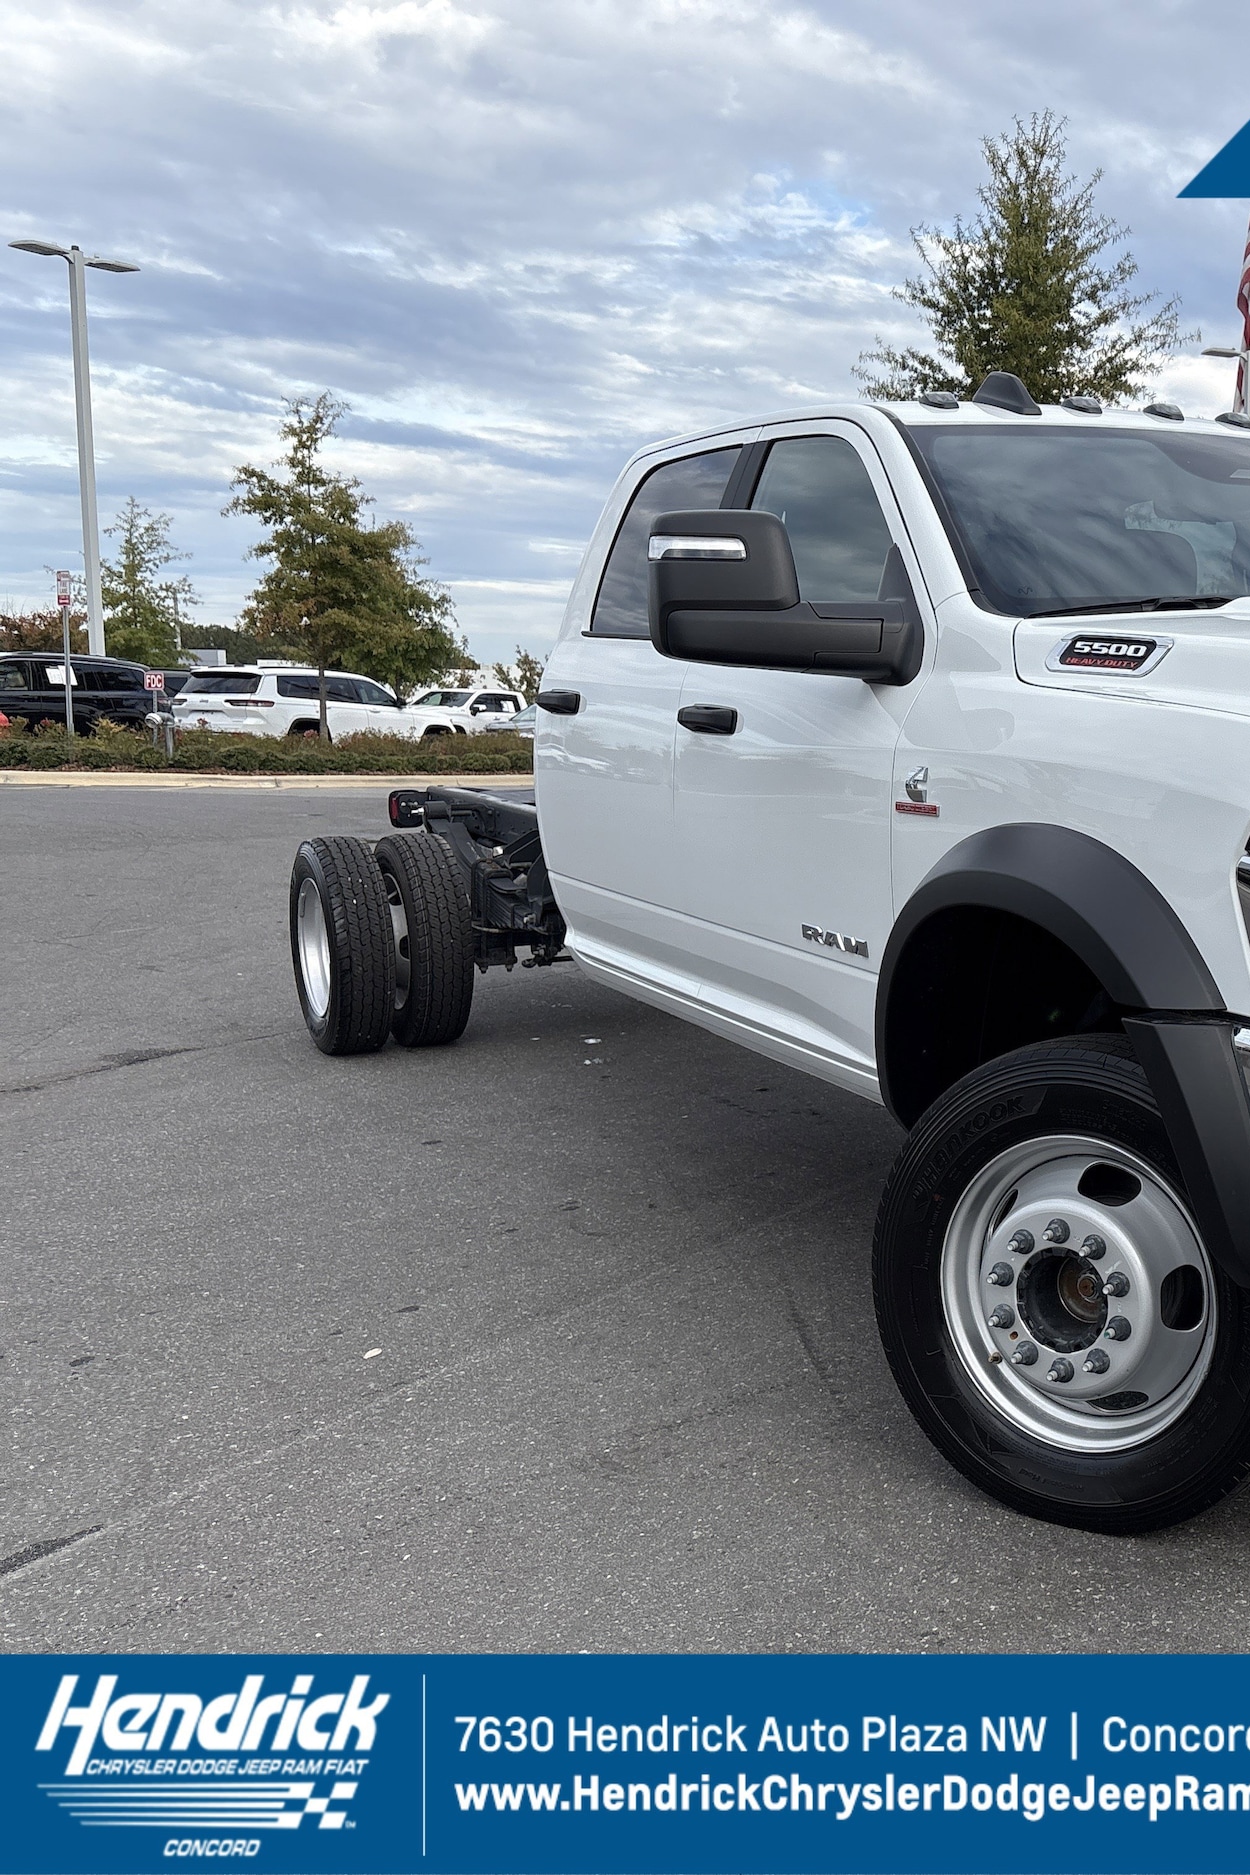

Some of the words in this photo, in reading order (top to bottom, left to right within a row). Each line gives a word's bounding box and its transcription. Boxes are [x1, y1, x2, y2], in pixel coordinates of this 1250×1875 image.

[1073, 640, 1147, 657] 5500
[1065, 656, 1104, 666] HEAVY
[1102, 659, 1138, 669] DUTY
[146, 675, 162, 688] FDC
[801, 922, 869, 958] RAM
